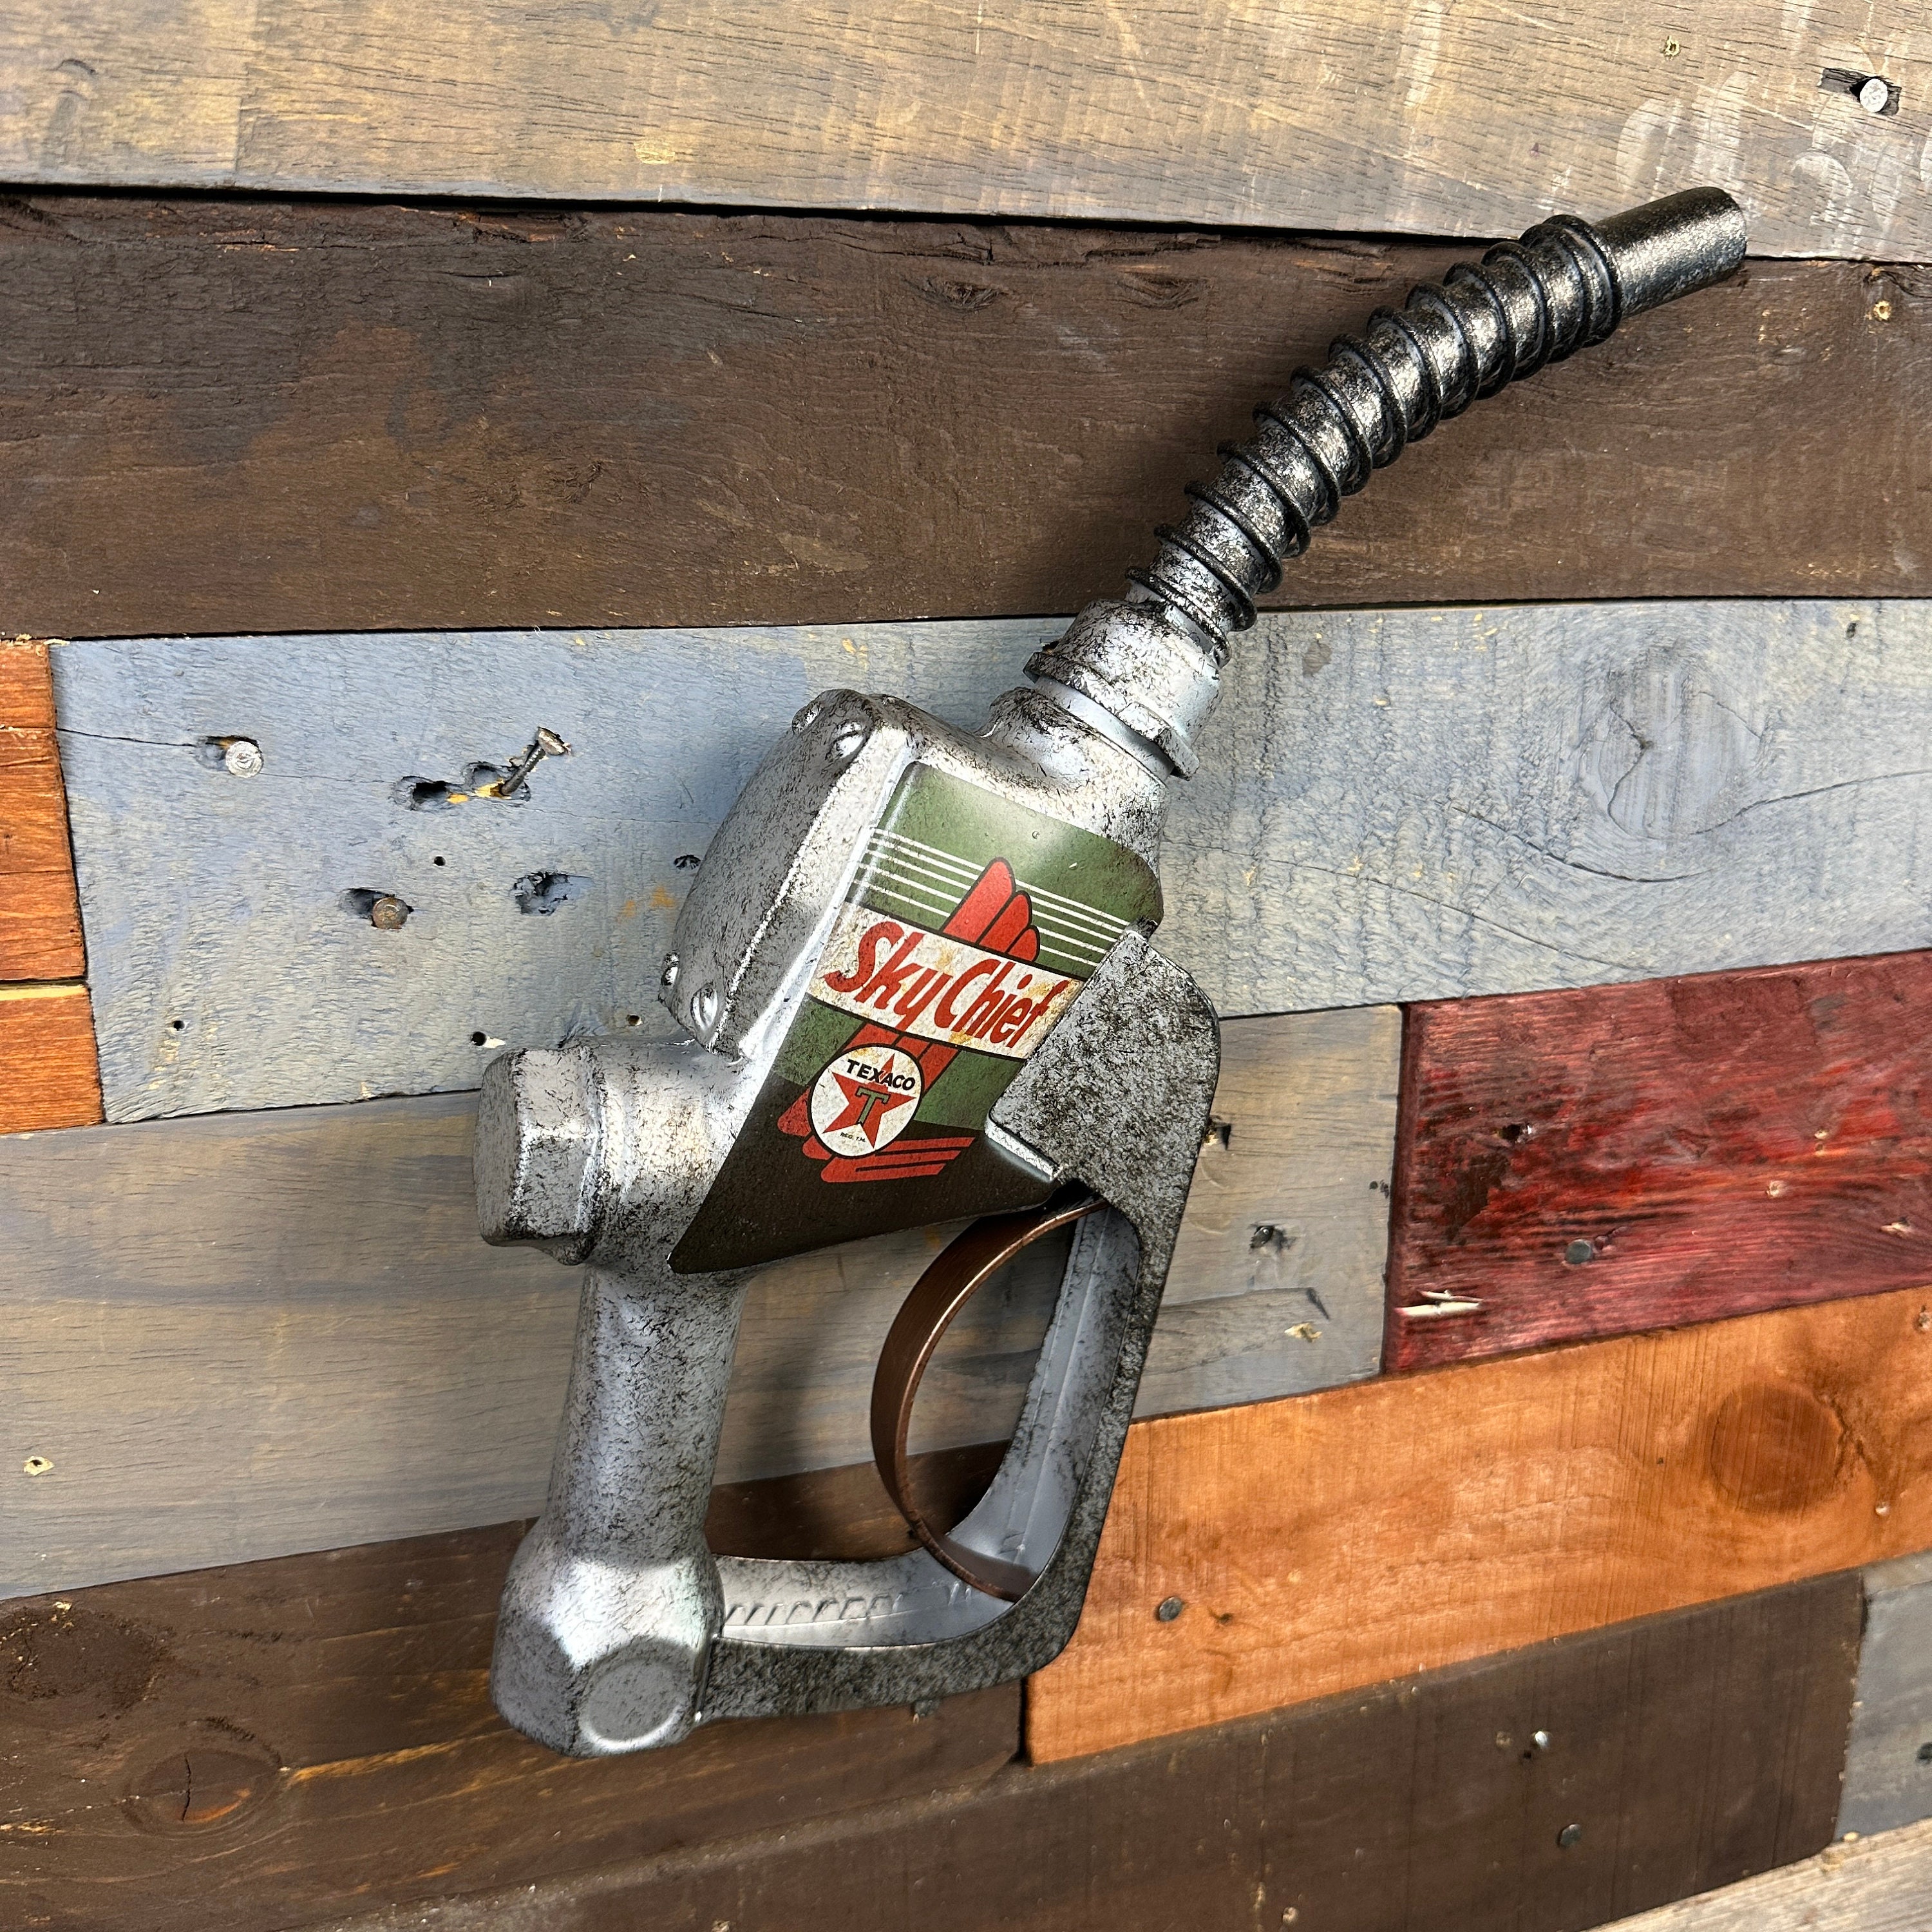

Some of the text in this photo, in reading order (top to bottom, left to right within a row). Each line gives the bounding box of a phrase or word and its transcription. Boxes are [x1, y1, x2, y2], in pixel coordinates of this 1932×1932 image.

[823, 920, 1070, 1048] Sky Chief
[846, 1058, 916, 1091] TEXACO
[855, 1086, 889, 1124] T
